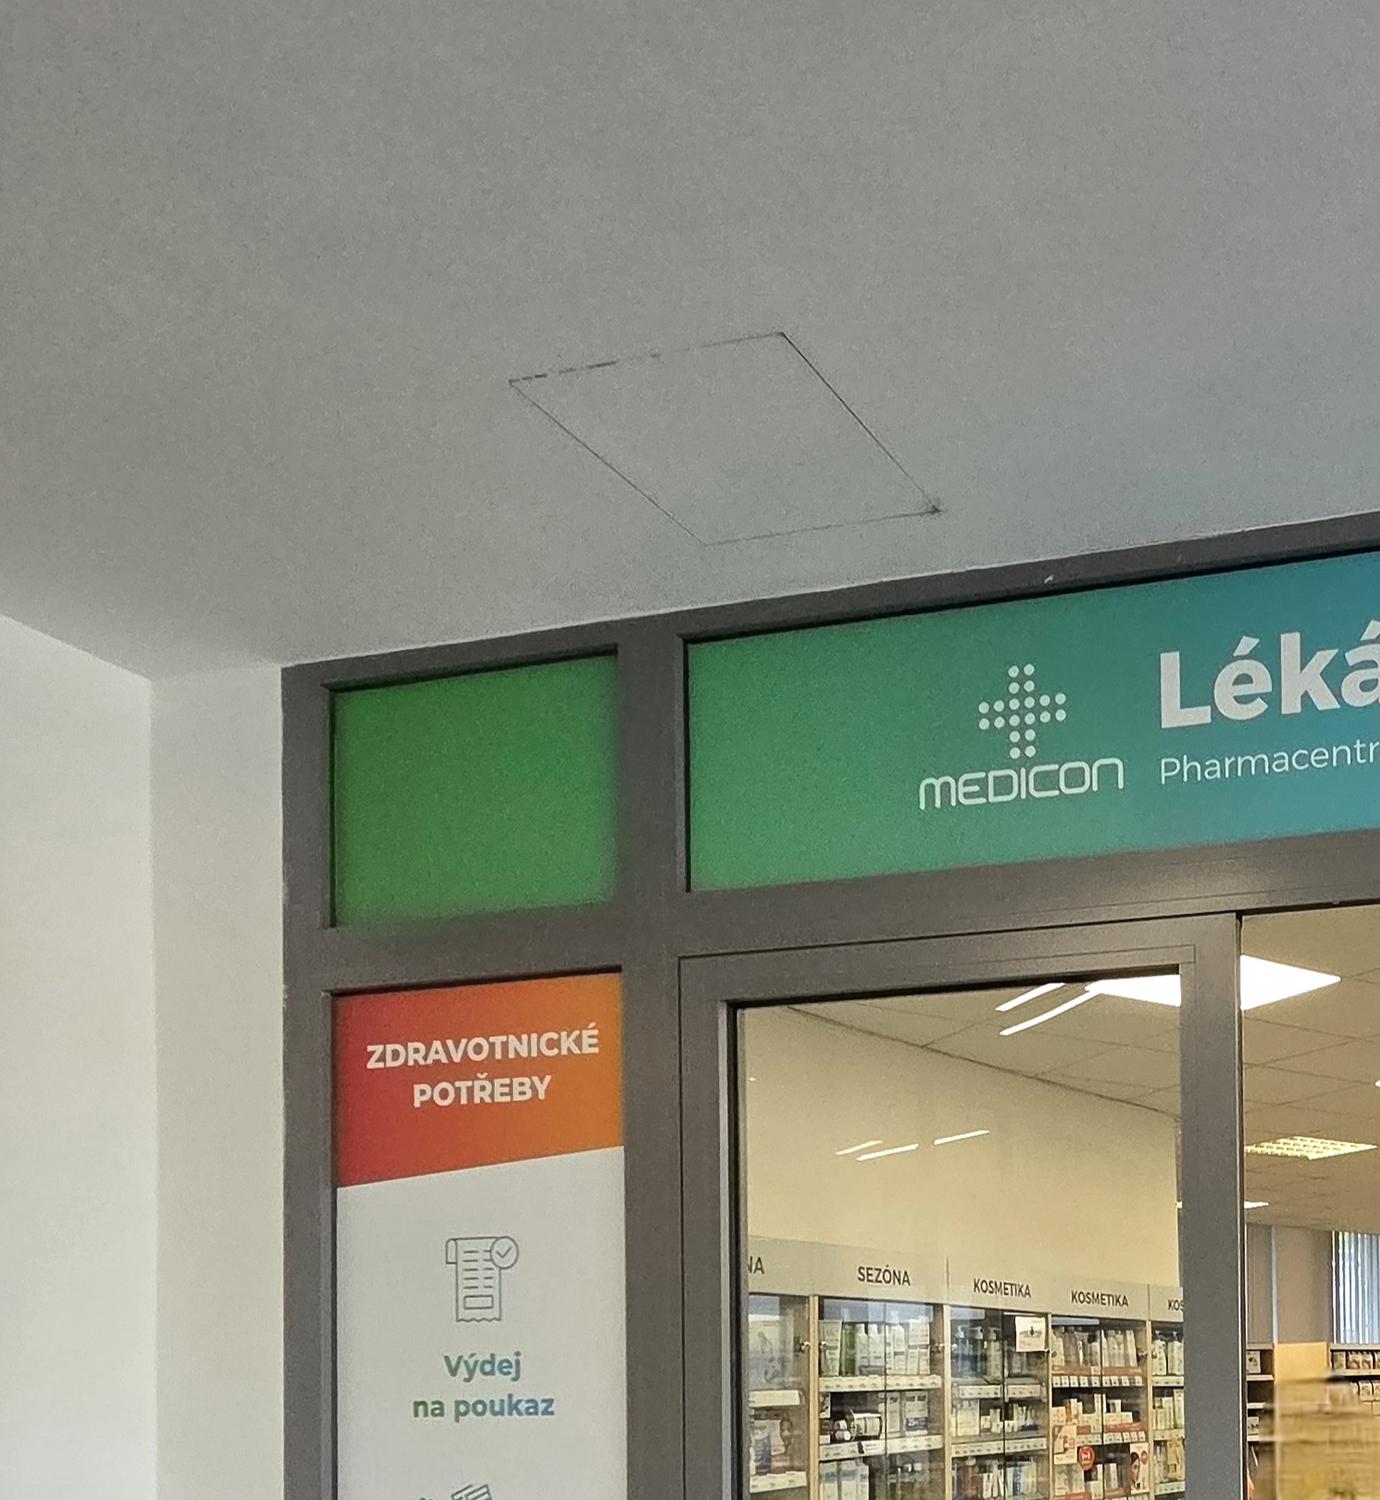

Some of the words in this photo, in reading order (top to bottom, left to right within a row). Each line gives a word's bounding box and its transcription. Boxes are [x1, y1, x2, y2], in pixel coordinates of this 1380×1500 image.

[366, 1022, 600, 1069] ZDRAVOTNICKÉ
[413, 1072, 551, 1108] POTŘEBY
[857, 1263, 911, 1287] SEZÓNA
[973, 1277, 1031, 1299] KOSMETIKA
[1070, 1290, 1129, 1308] KOSMETIKA
[444, 1350, 521, 1382] Výdej
[412, 1400, 444, 1418] na
[454, 1396, 555, 1423] poukaz
